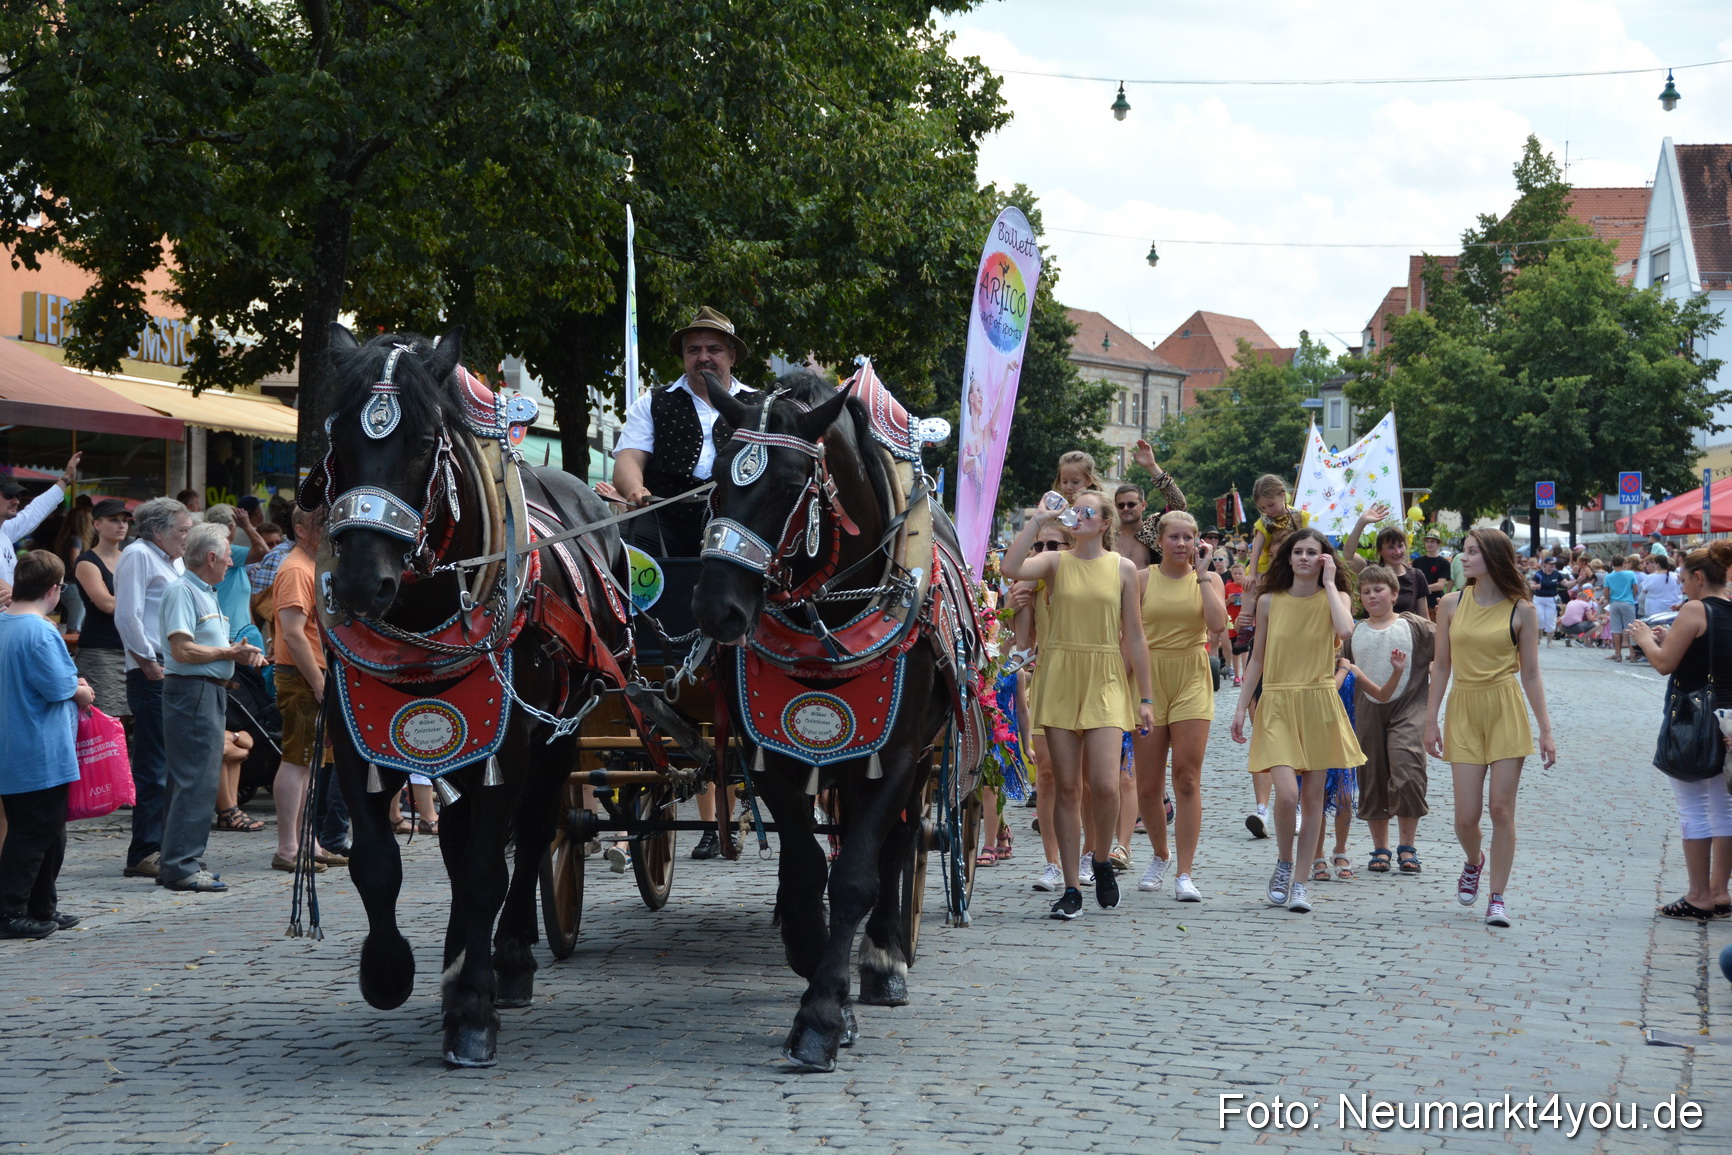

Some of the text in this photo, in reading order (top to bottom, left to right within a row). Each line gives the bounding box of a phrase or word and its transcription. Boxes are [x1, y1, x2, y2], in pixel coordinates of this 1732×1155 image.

[998, 222, 1035, 257] Ballett
[1538, 499, 1554, 507] TAXI
[1621, 495, 1640, 503] TAXI
